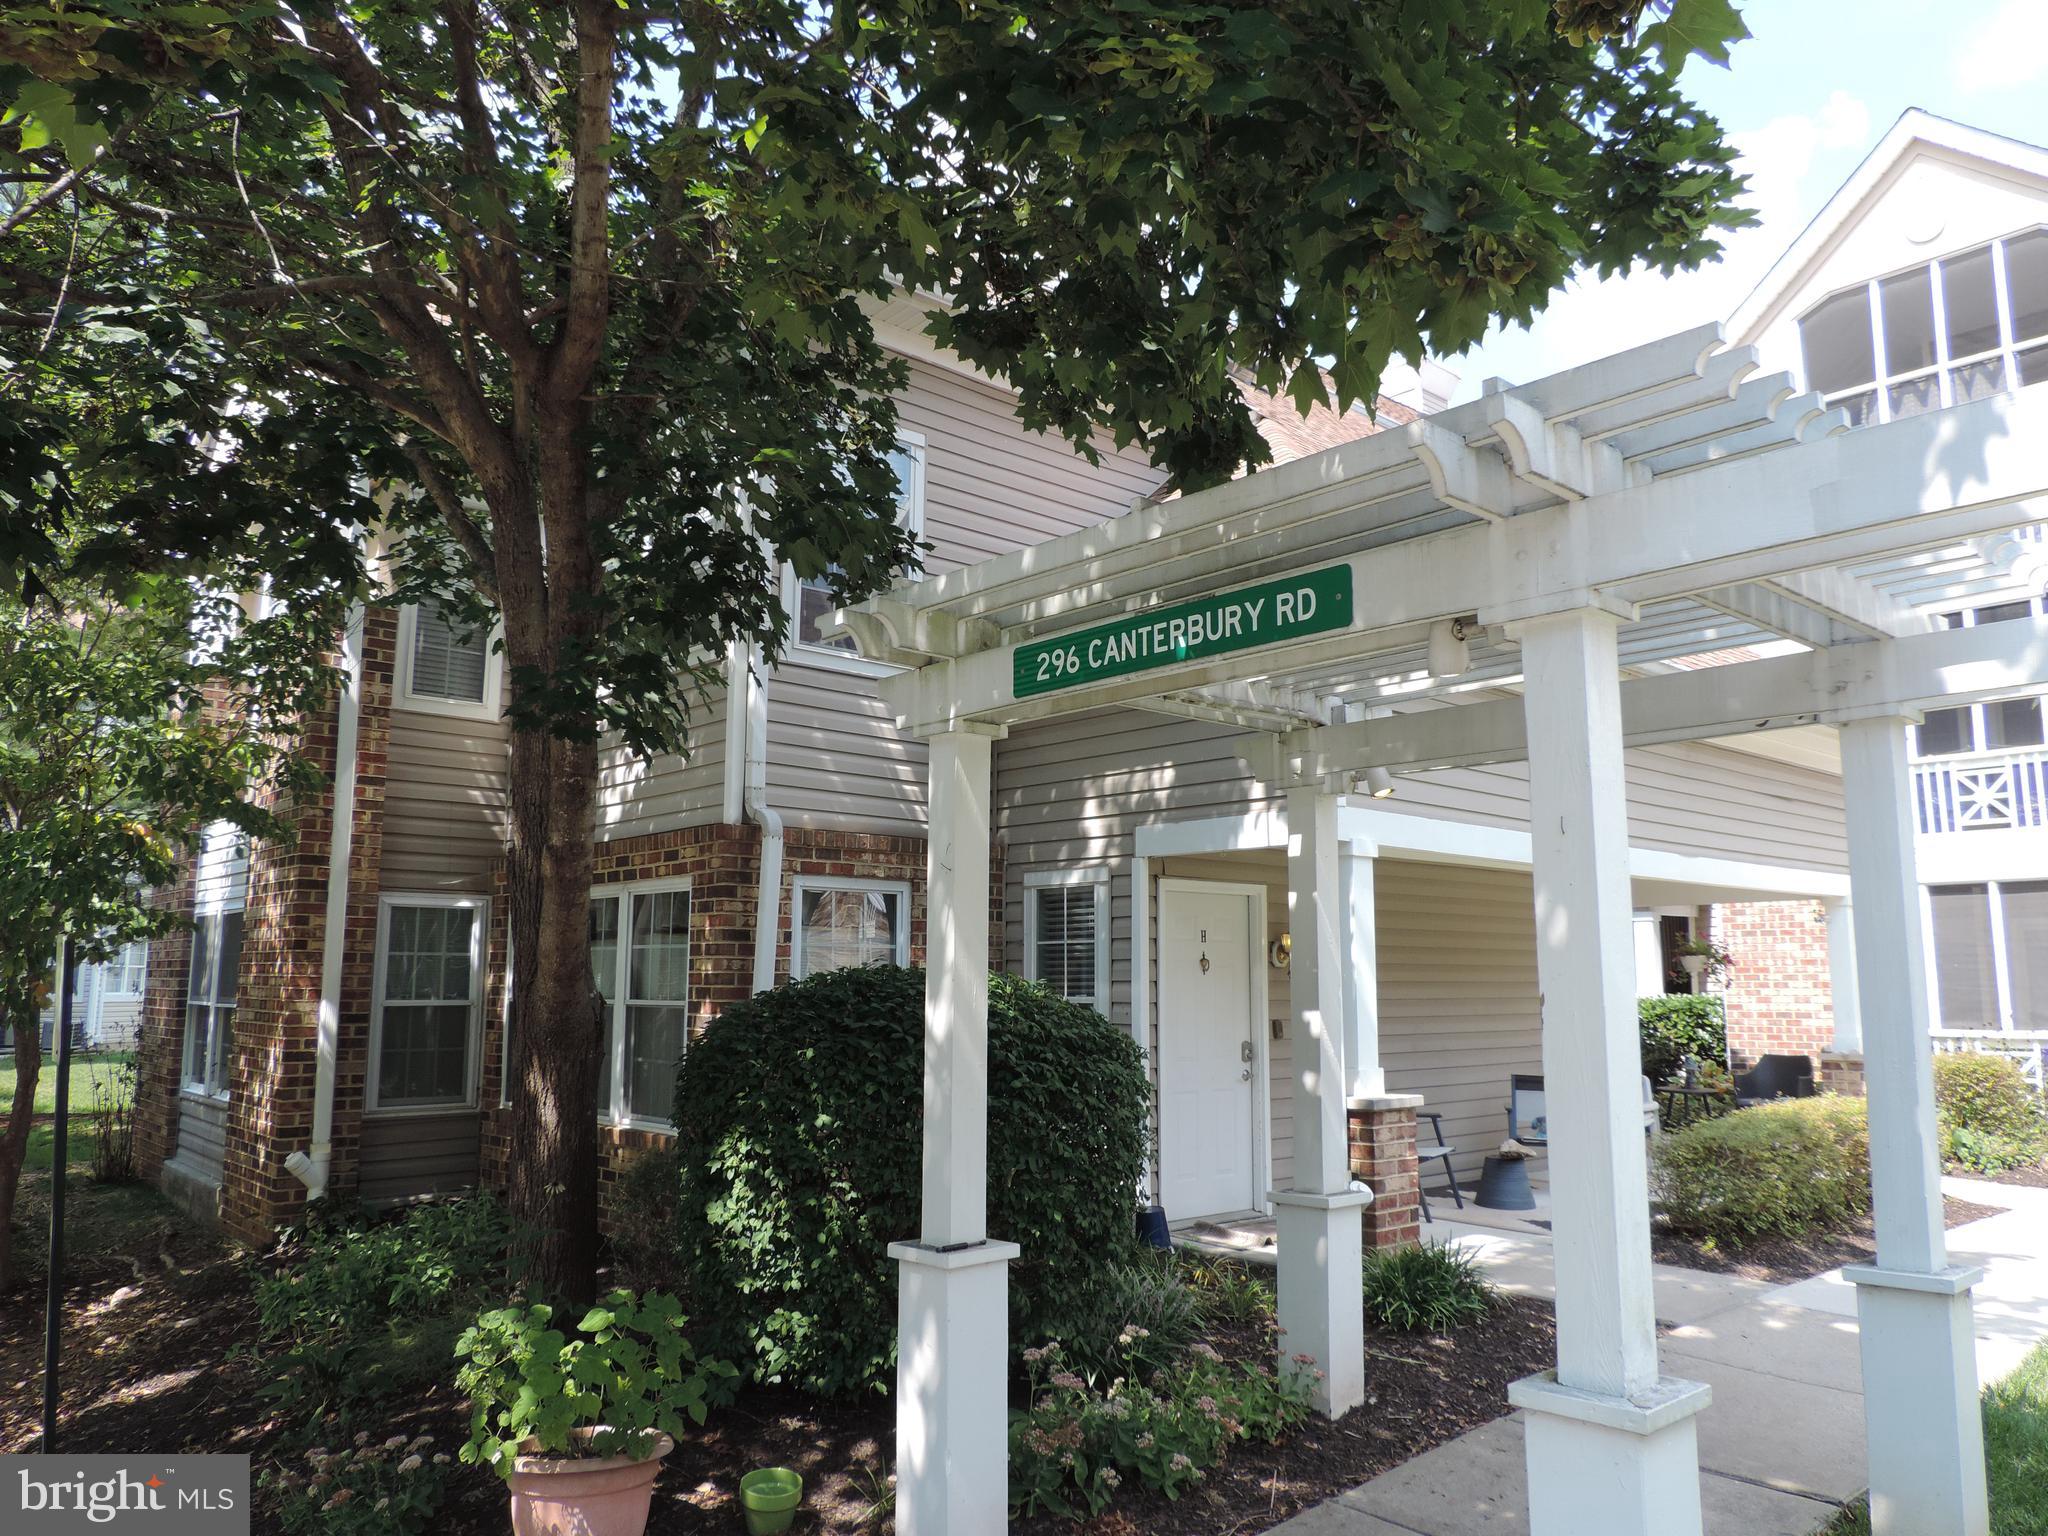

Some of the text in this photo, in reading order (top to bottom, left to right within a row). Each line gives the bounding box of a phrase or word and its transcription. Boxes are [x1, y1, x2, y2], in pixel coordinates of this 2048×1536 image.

[1036, 587, 1316, 681] 296 CANTERBURY RD
[1200, 929, 1207, 943] H
